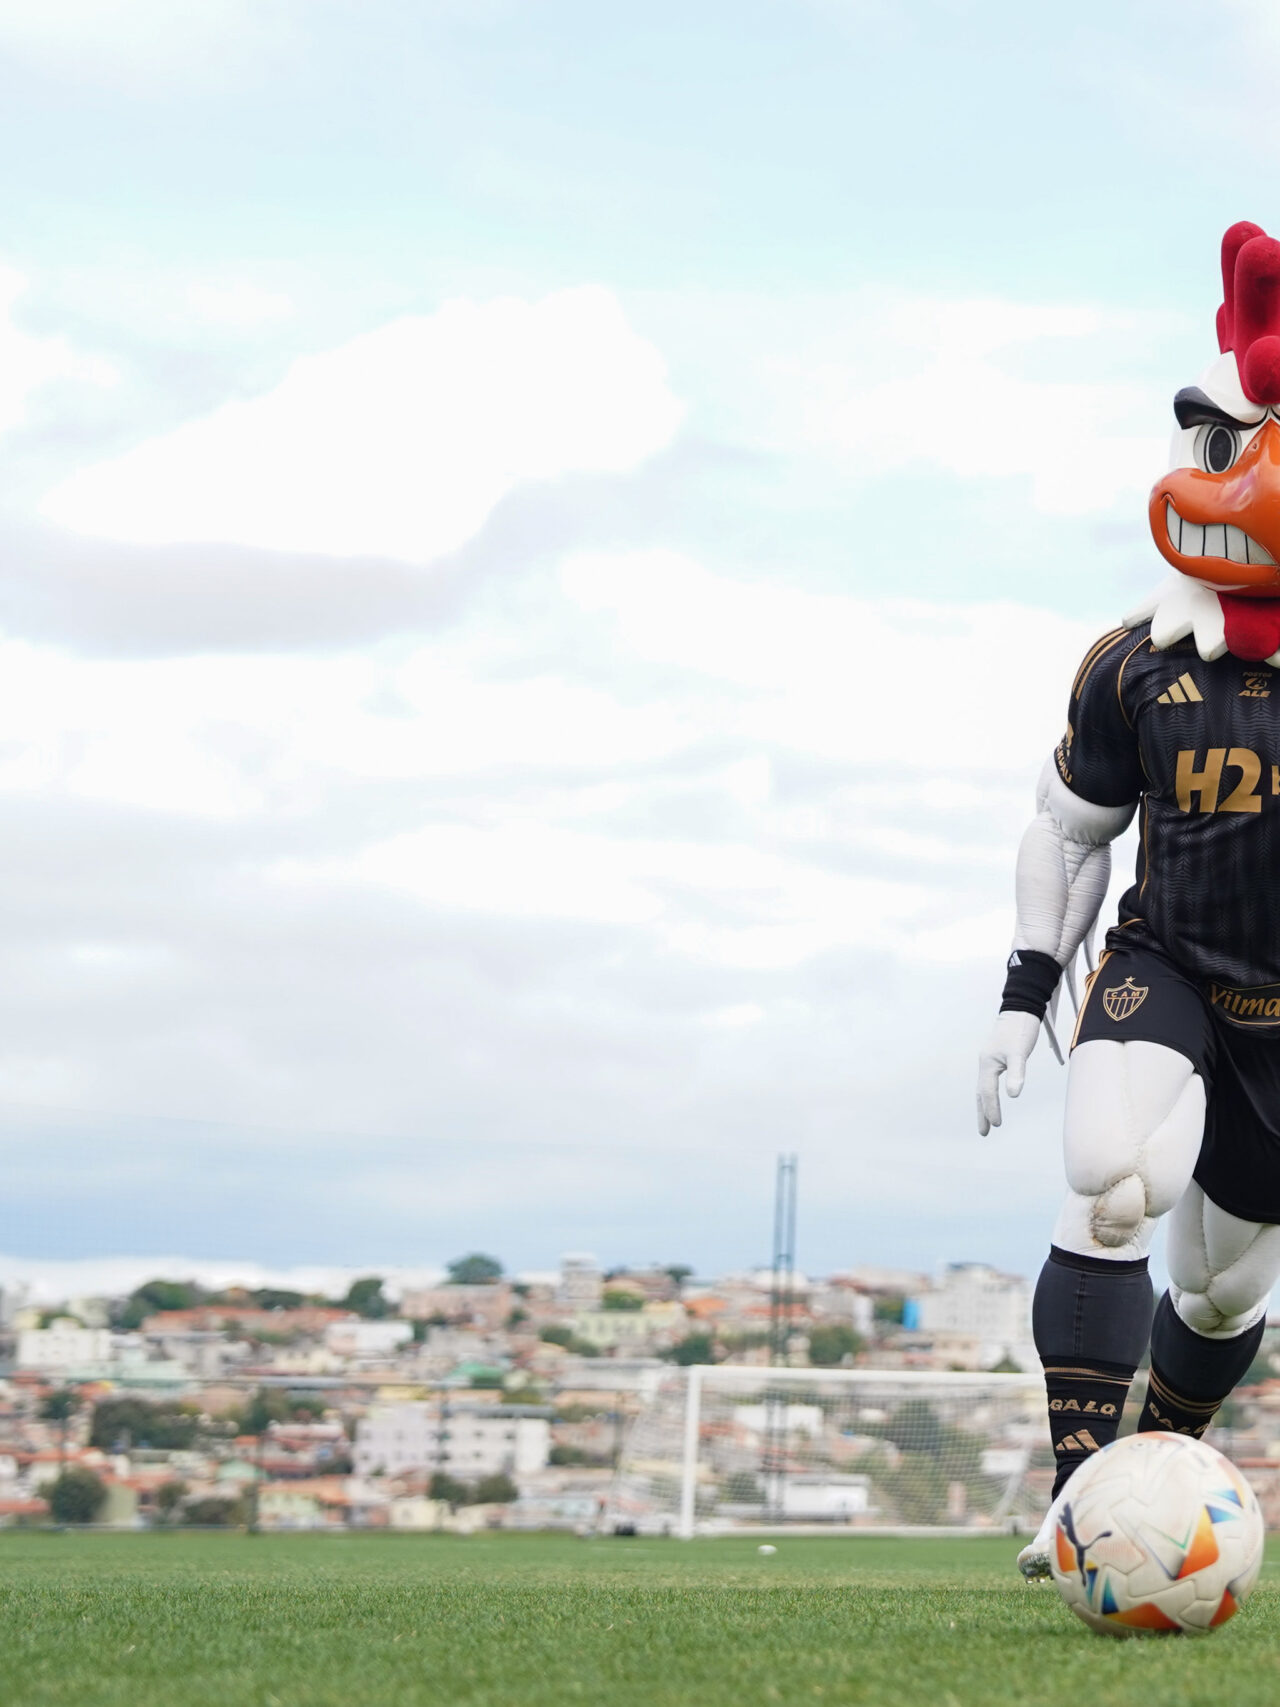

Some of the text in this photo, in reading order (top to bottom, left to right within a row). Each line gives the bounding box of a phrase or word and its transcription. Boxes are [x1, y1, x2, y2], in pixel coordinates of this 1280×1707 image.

[1238, 690, 1271, 698] ALE
[1175, 747, 1262, 814] H2
[1049, 1399, 1117, 1416] GALO
